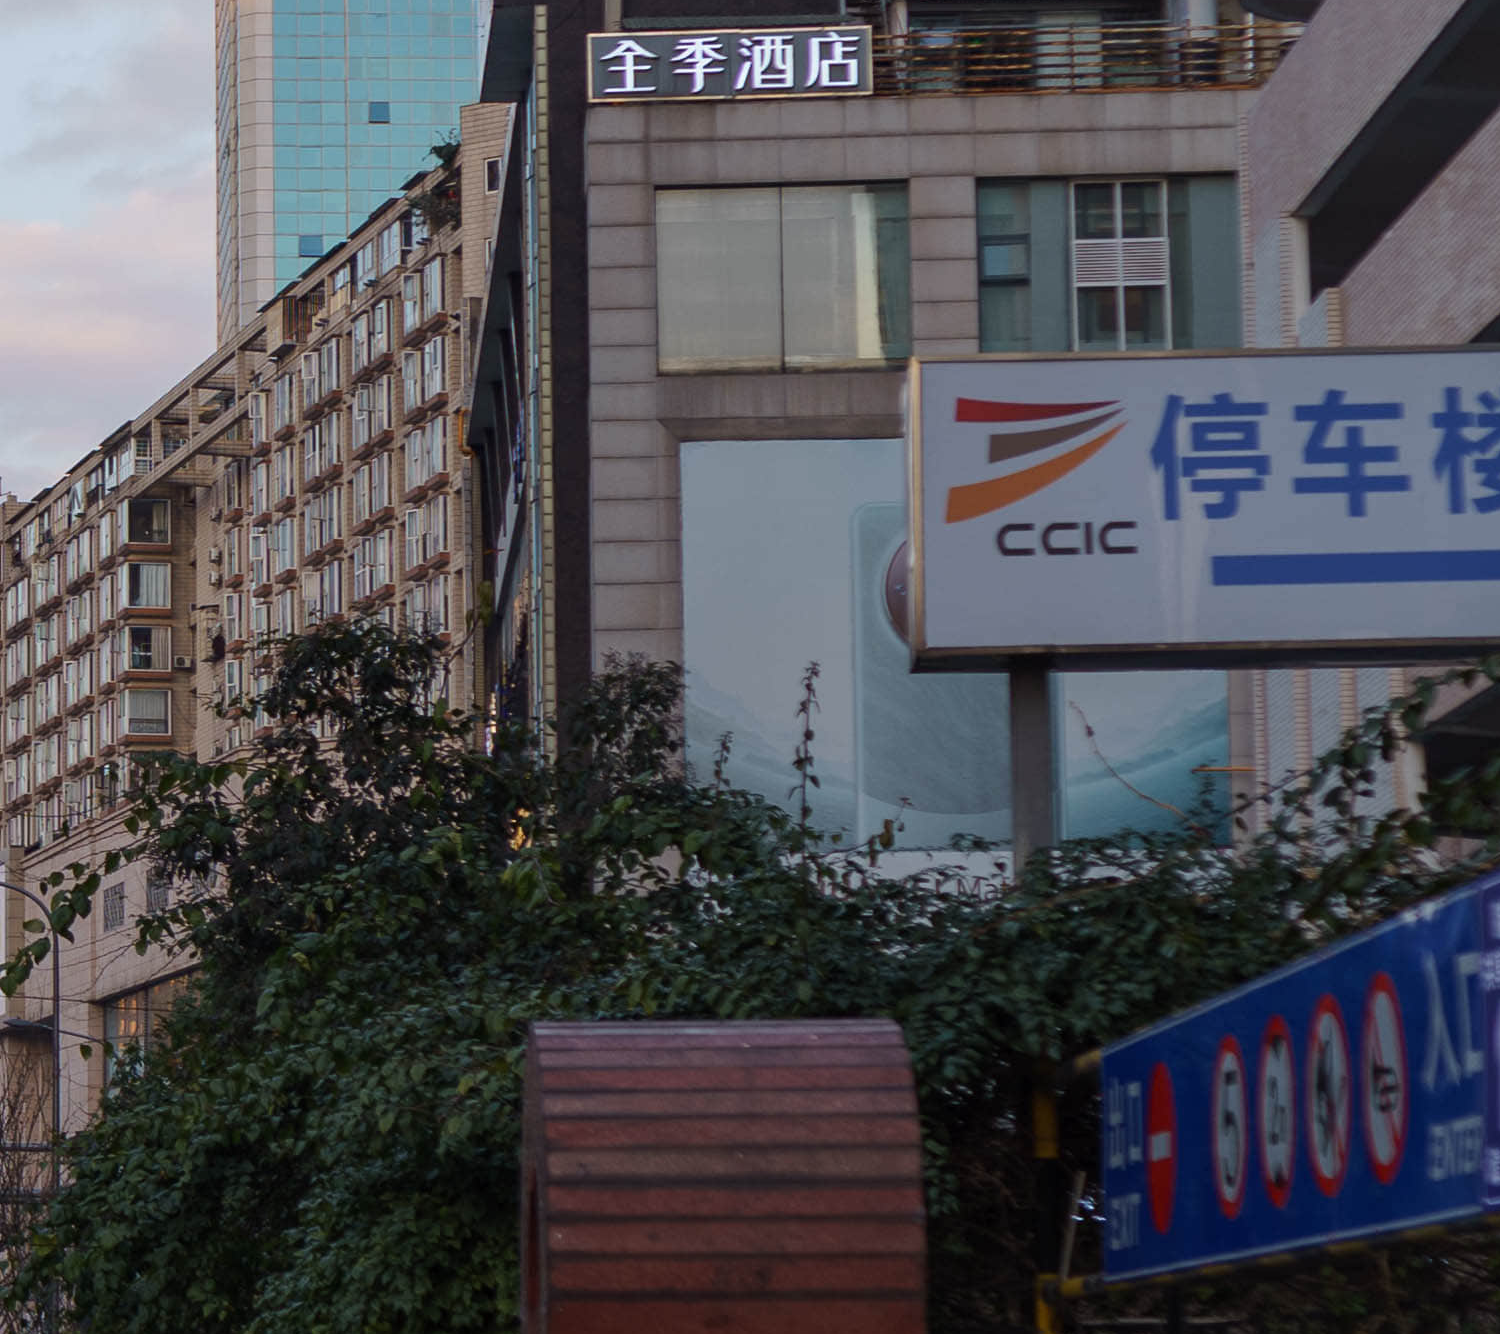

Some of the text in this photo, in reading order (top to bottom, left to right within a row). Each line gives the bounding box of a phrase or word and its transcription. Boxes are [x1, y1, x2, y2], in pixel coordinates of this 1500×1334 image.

[600, 32, 860, 95] 全季酒店
[995, 519, 1138, 557] CCIC
[1422, 951, 1484, 1094] 入口
[1225, 1068, 1242, 1188] 5
